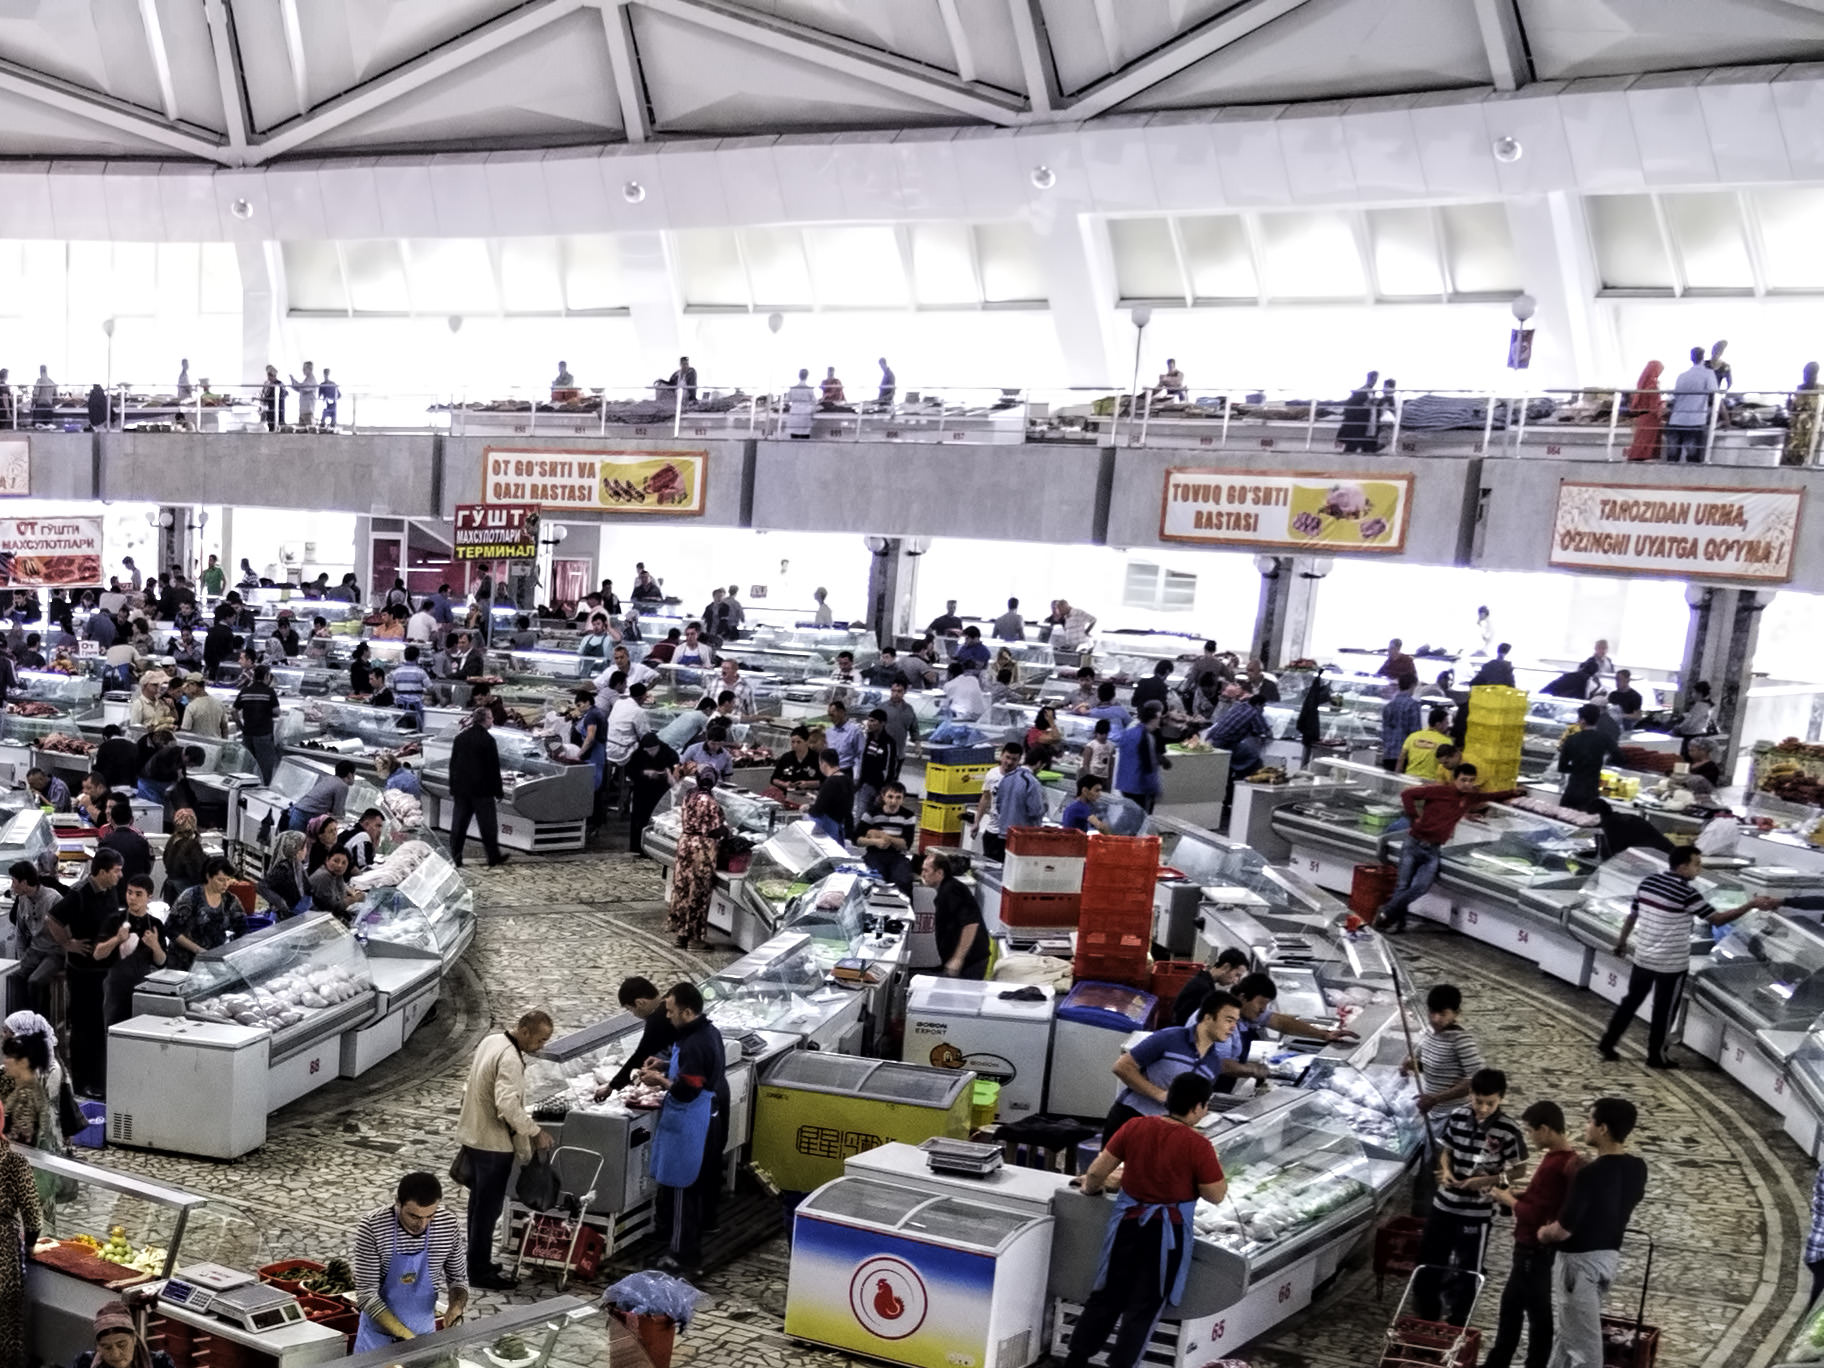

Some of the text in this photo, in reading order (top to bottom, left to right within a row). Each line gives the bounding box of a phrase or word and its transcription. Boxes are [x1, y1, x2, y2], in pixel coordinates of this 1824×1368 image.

[492, 459, 510, 477] OT
[577, 462, 596, 479] VA
[493, 483, 592, 502] QAZI RASTASI
[1172, 483, 1222, 505] TOVUQ
[457, 506, 525, 527] ГЎШТ
[1194, 511, 1259, 533] RASTASI
[1599, 499, 1749, 532] TAROZIDAN URMA,
[456, 544, 535, 558] ТЕРМИНАЛ
[1635, 532, 1699, 560] UYATGA
[1211, 1319, 1225, 1341] 65
